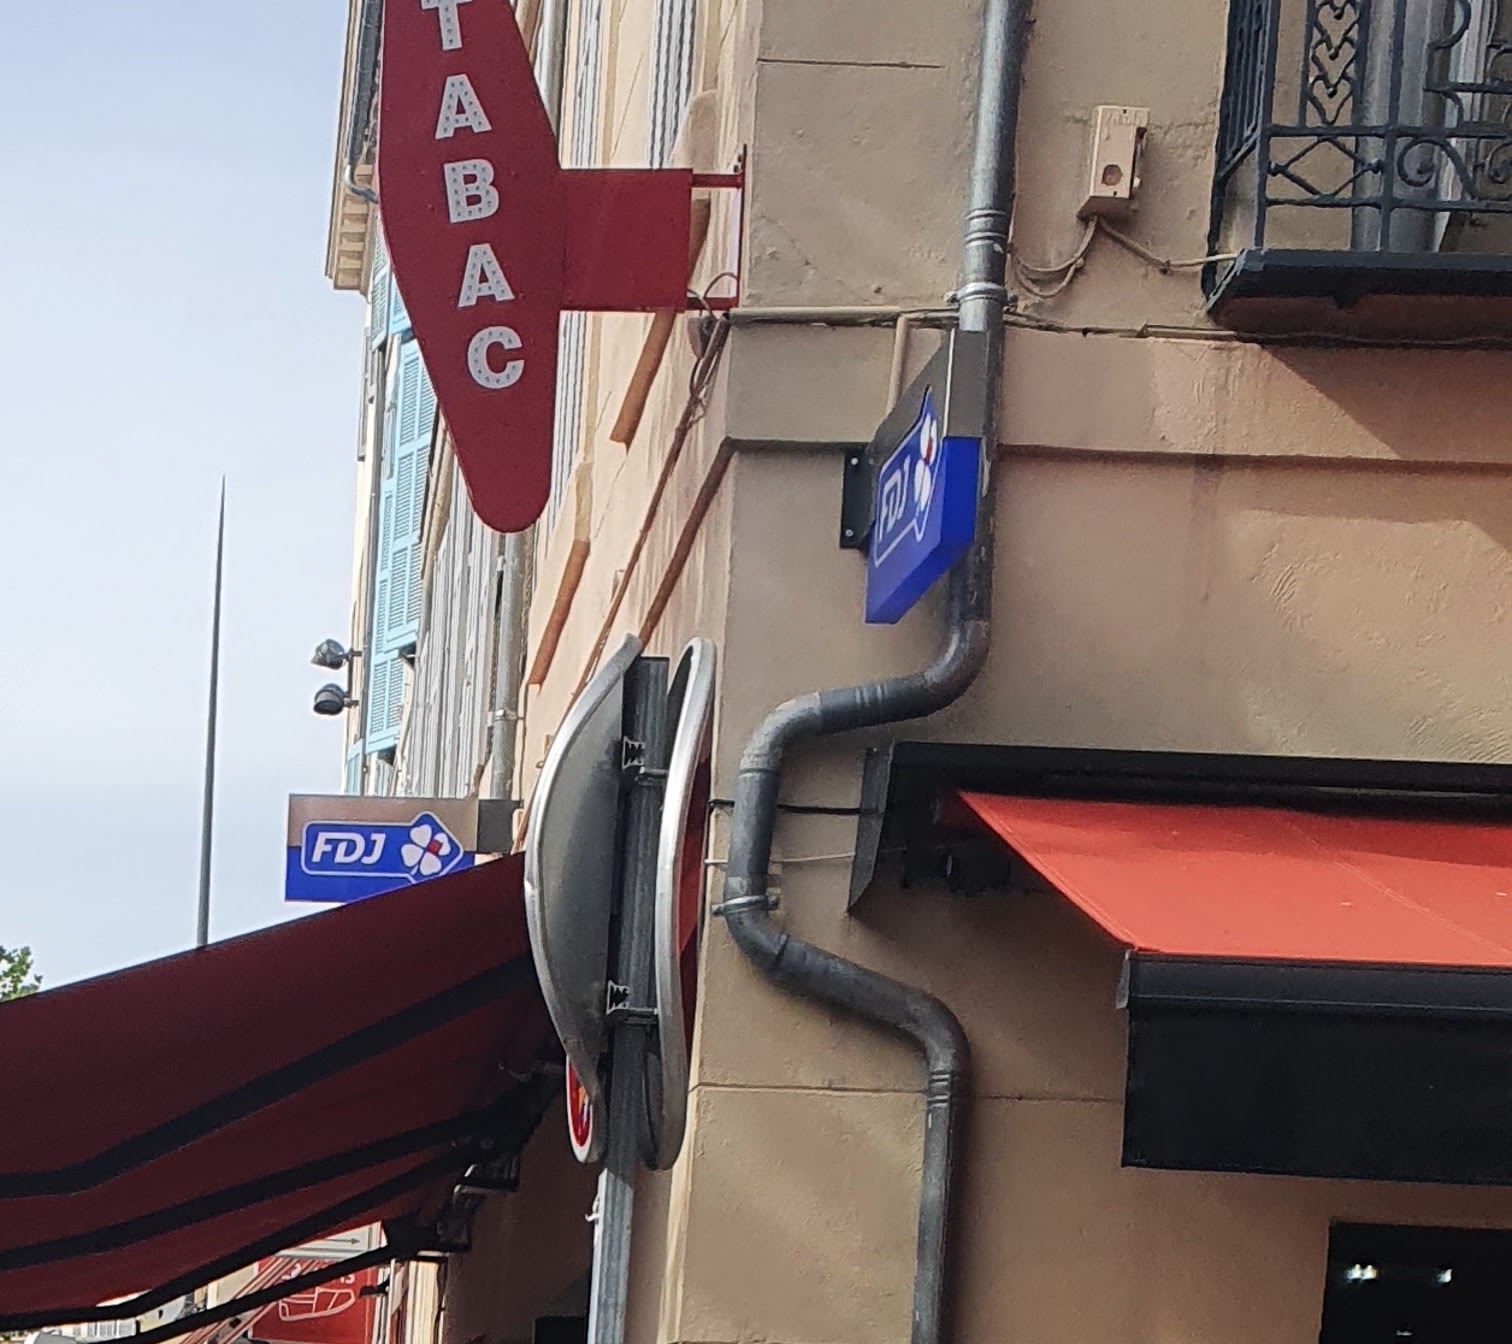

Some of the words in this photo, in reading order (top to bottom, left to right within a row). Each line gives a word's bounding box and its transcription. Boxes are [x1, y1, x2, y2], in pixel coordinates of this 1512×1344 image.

[421, 0, 525, 390] TABAC
[878, 453, 912, 543] FDJ
[311, 831, 386, 865] FDJ
